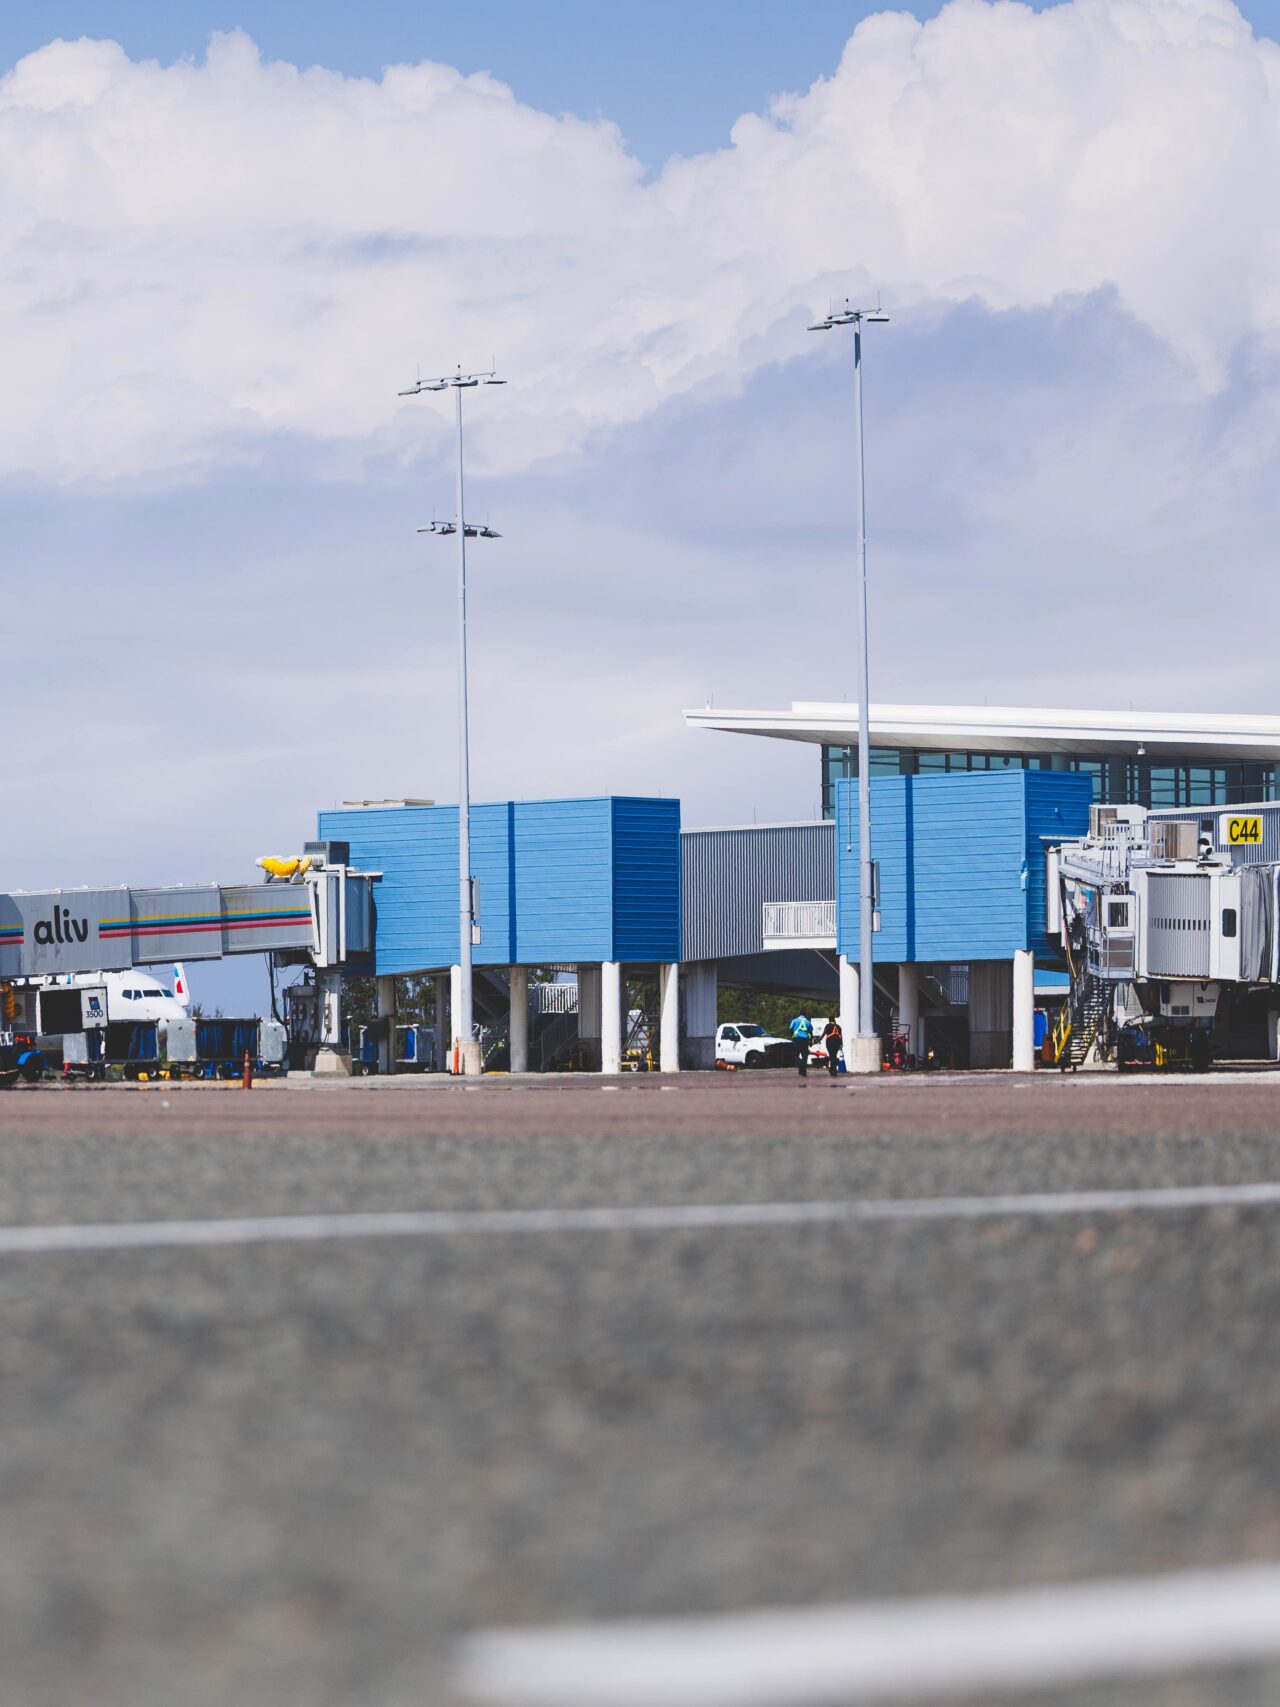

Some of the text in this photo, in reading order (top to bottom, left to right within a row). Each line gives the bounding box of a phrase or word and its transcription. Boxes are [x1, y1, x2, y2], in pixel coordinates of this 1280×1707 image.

[1229, 819, 1259, 842] C44
[33, 904, 89, 945] aliv
[85, 1010, 104, 1019] 3500
